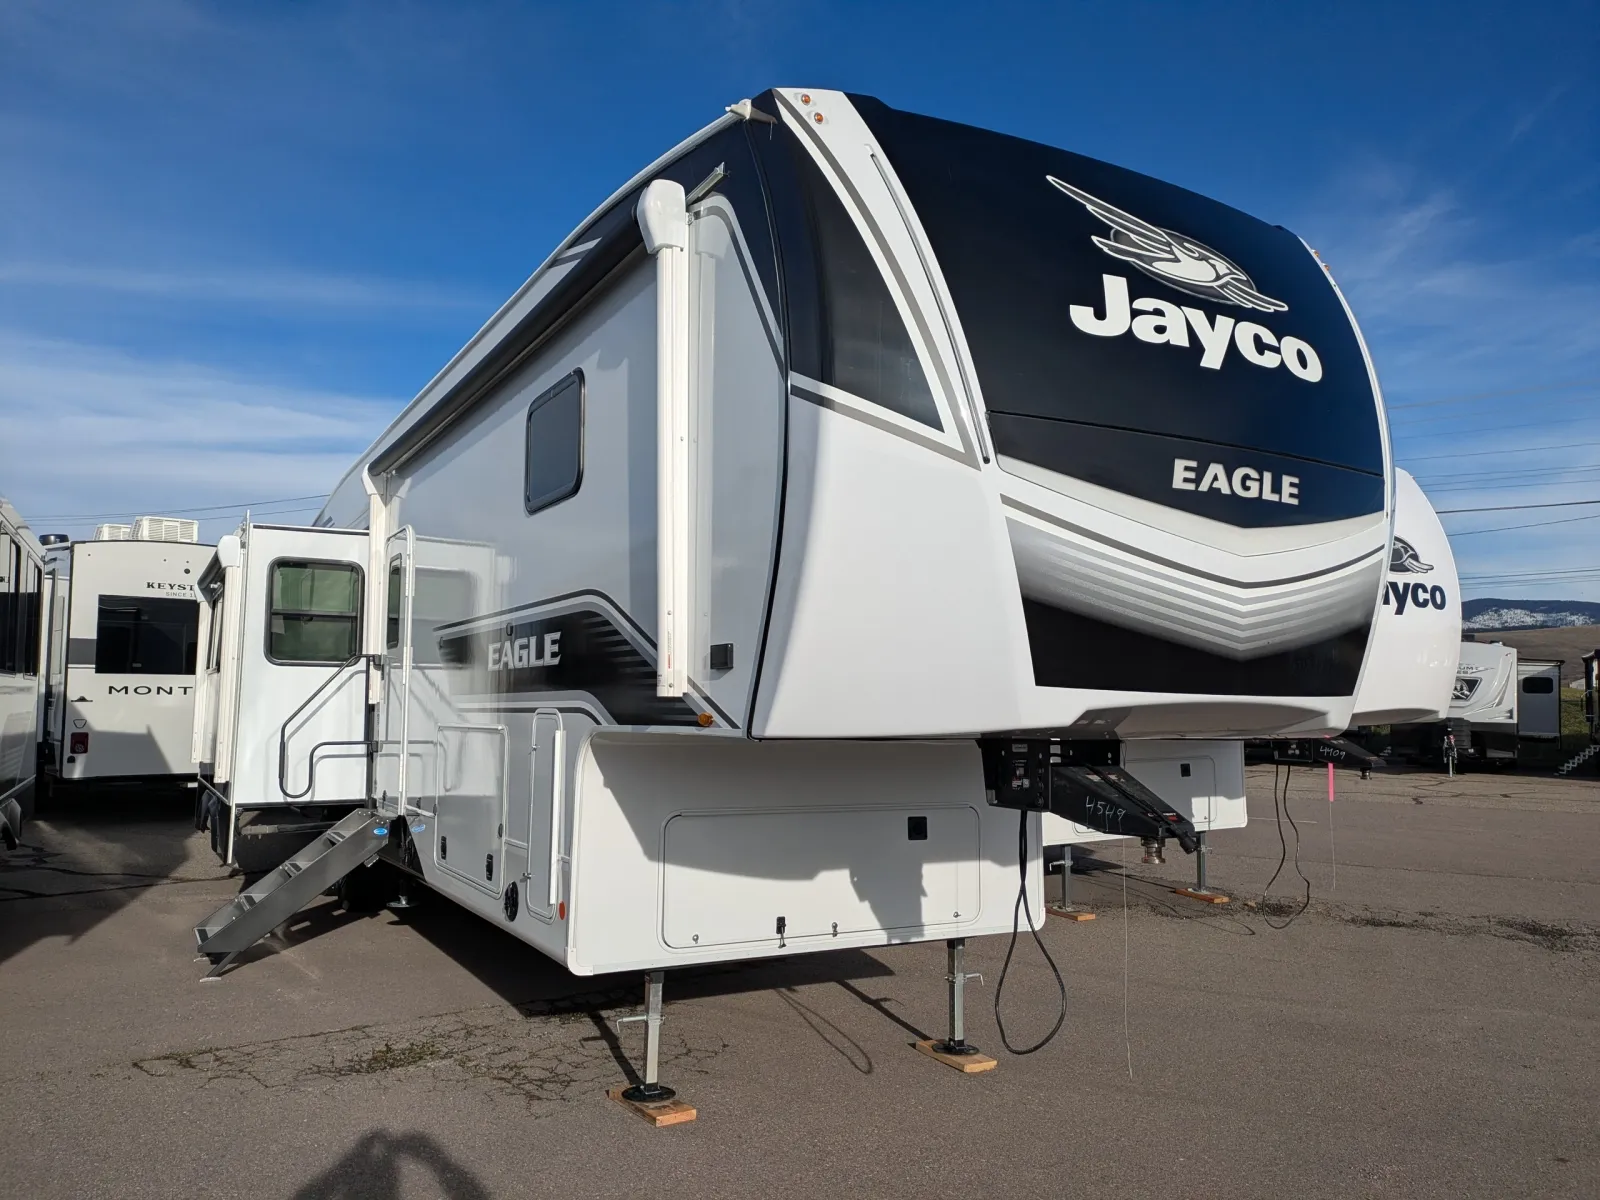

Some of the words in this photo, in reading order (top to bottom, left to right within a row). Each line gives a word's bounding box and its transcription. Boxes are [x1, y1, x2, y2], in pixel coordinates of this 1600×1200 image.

[1069, 273, 1323, 383] Jayco
[1172, 458, 1300, 505] EAGLE
[487, 631, 562, 671] EAGLE
[108, 685, 194, 696] MONT
